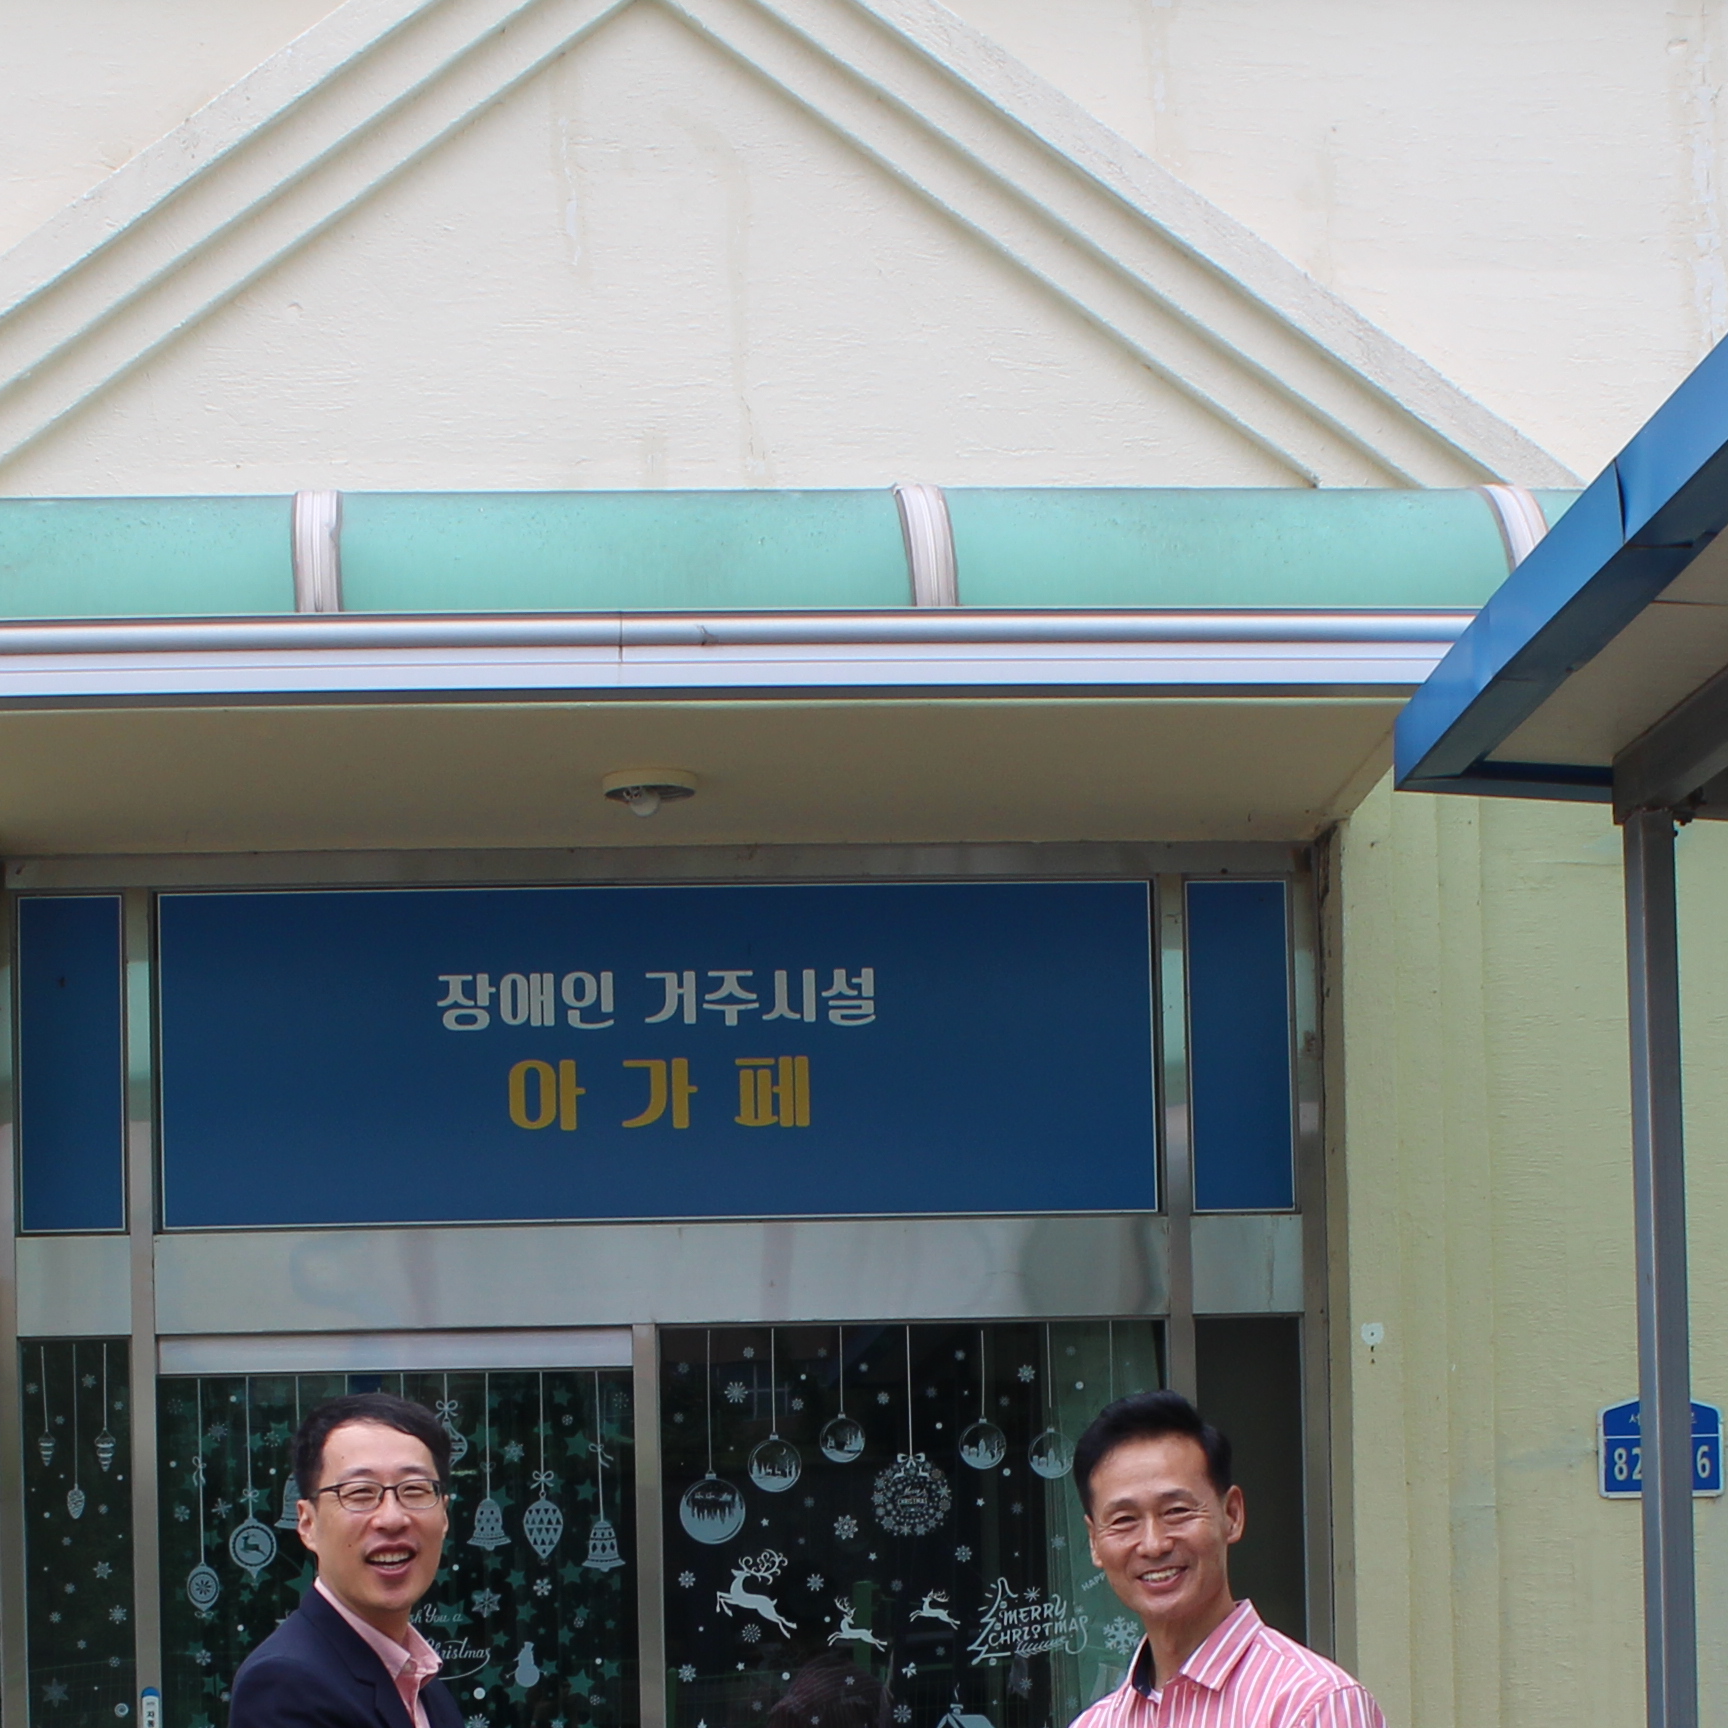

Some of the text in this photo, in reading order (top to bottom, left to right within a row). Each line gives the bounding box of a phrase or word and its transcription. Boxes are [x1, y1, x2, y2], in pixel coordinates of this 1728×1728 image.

[436, 967, 877, 1031] 장애인 거주시설
[1081, 1572, 1106, 1592] HAPP
[999, 1594, 1066, 1627] MERRY
[988, 1615, 1088, 1654] CHRISTMAS
